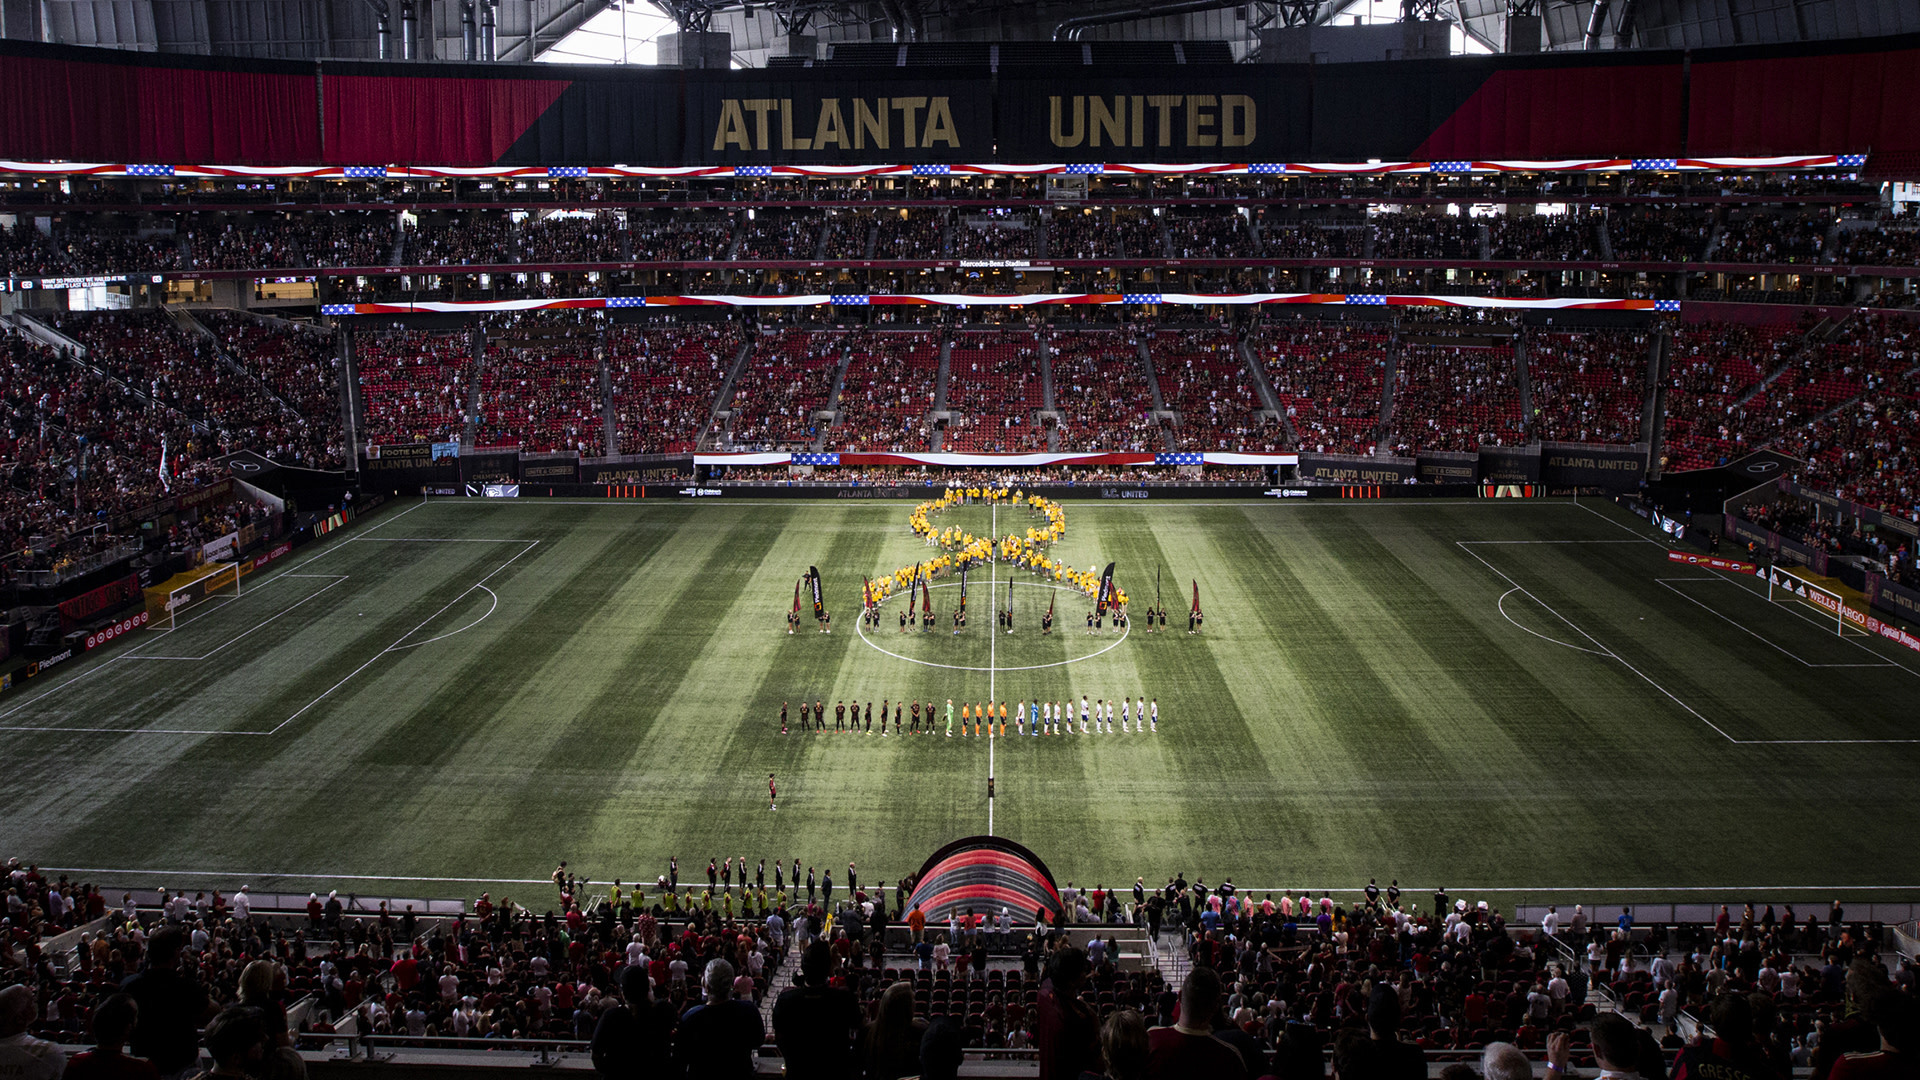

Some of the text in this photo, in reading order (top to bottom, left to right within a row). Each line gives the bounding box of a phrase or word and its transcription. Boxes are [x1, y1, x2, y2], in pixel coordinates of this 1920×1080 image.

[713, 94, 1257, 151] ATLANTA UNITED
[381, 448, 411, 457] FOOTIE
[368, 458, 412, 470] ATLANTA
[1549, 456, 1639, 471] ATLANTA UNITED
[596, 467, 679, 481] ATLANTA UNITED
[1315, 467, 1399, 482] ATLANTA UNITED
[837, 489, 873, 498] ATLANTA
[1121, 490, 1149, 499] UNITED
[256, 555, 269, 566] Audi
[1809, 588, 1836, 611] WELLS
[1881, 589, 1913, 609] ATLANTA
[1879, 623, 1900, 643] Captain
[1897, 632, 1920, 652] Morgan
[38, 649, 72, 671] Piedmont
